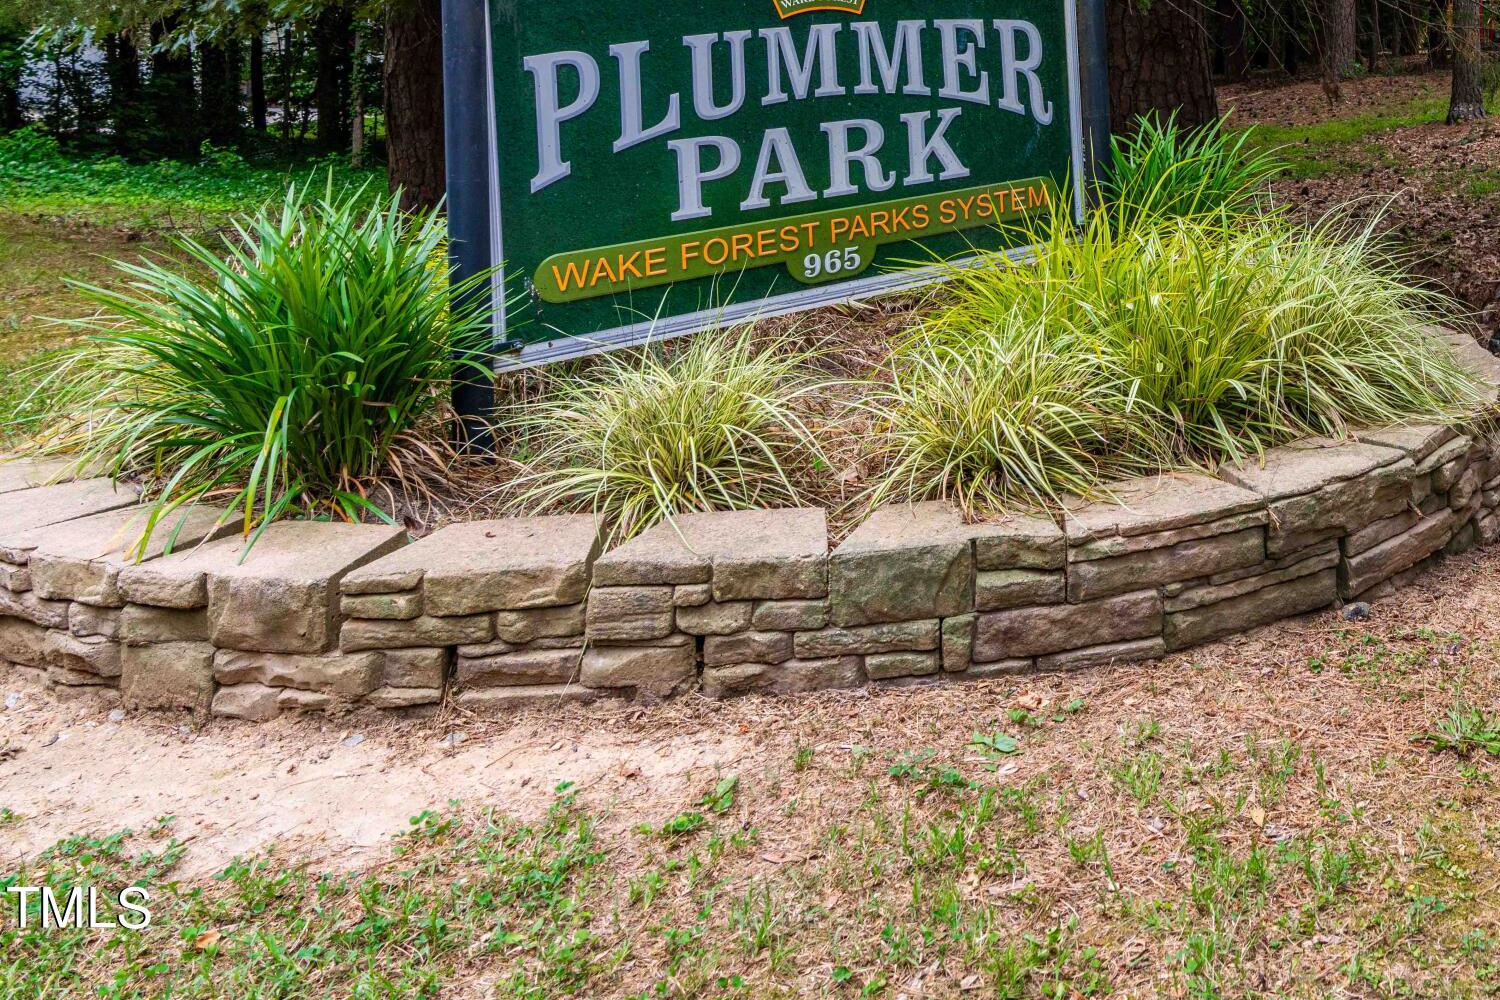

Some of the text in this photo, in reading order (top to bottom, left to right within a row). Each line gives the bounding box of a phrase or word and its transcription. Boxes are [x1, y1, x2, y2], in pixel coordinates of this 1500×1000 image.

[523, 17, 1054, 195] PLUMMER
[667, 106, 970, 222] PARK
[552, 186, 1050, 292] WAKE FOREST PARKS SYSTEM
[803, 245, 861, 279] 965
